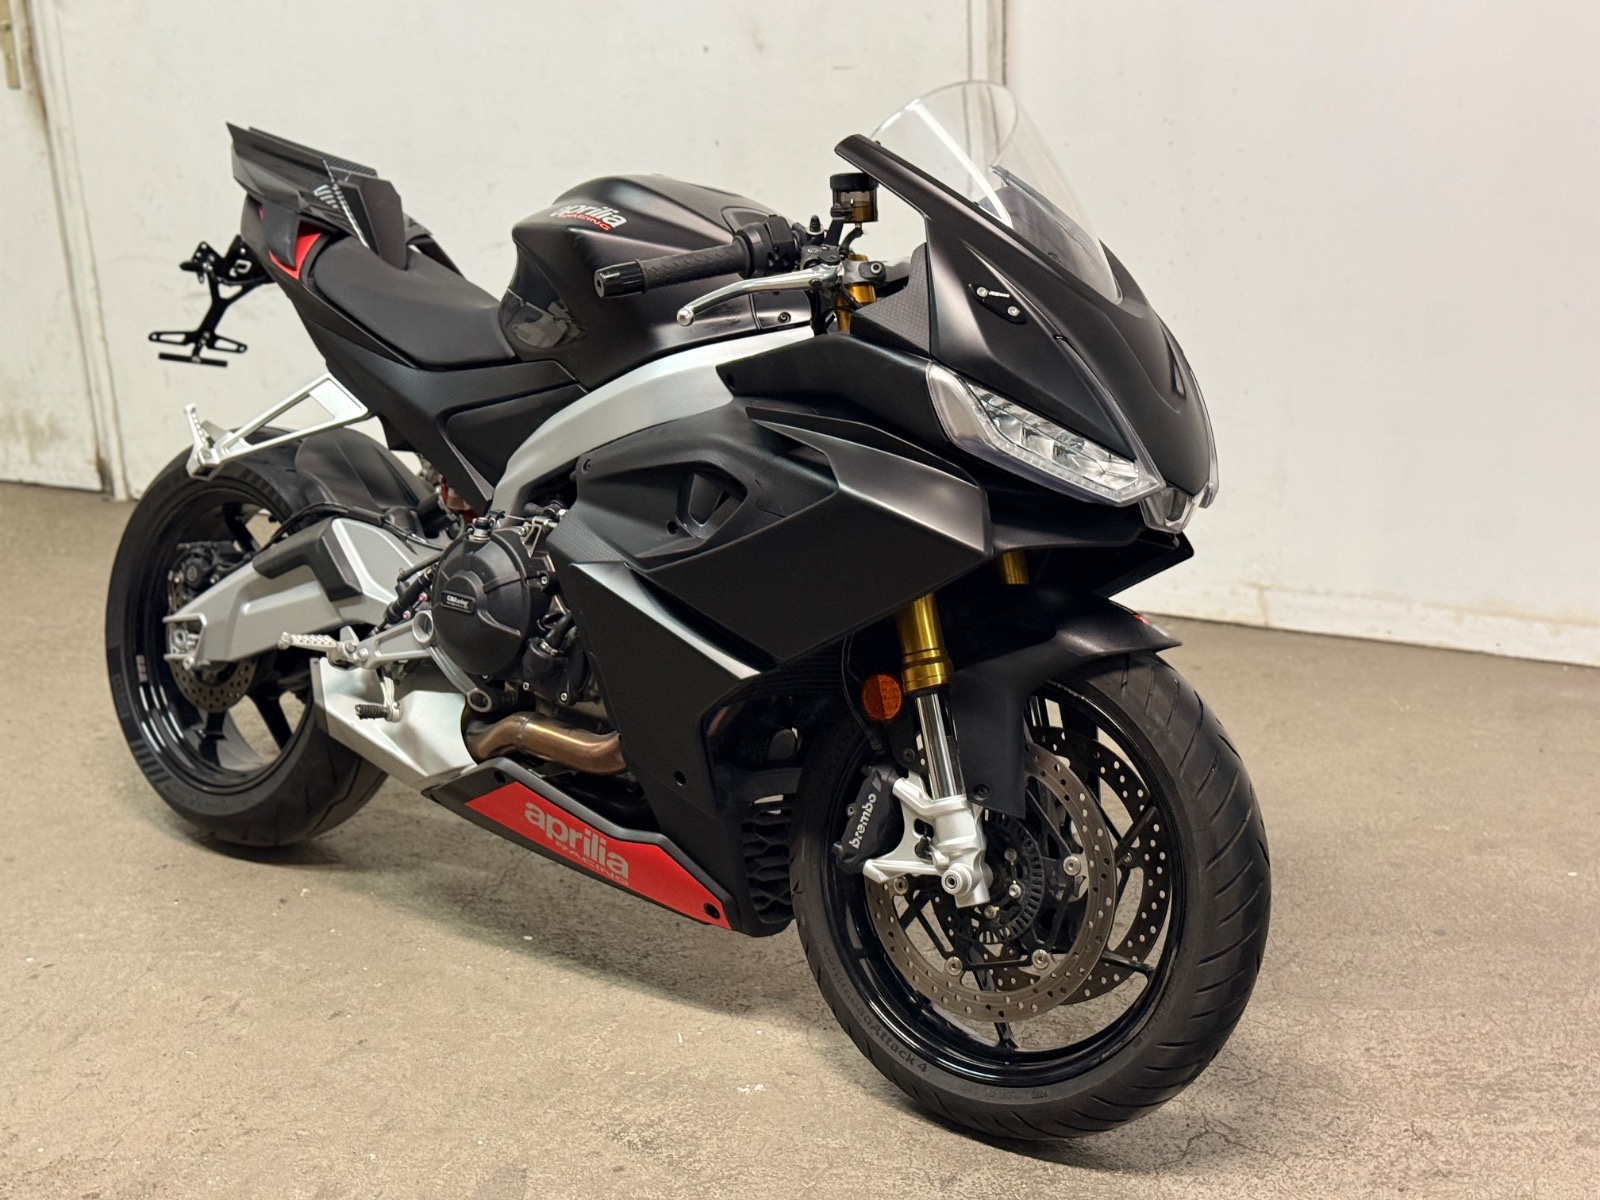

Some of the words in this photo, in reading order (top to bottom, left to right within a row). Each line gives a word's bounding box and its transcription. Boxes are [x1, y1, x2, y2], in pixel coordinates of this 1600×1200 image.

[549, 204, 627, 229] aprilia
[560, 212, 611, 231] RACING
[848, 793, 877, 850] brembo
[524, 801, 629, 880] aprilia
[556, 840, 629, 887] RACING
[917, 1062, 928, 1073] 4
